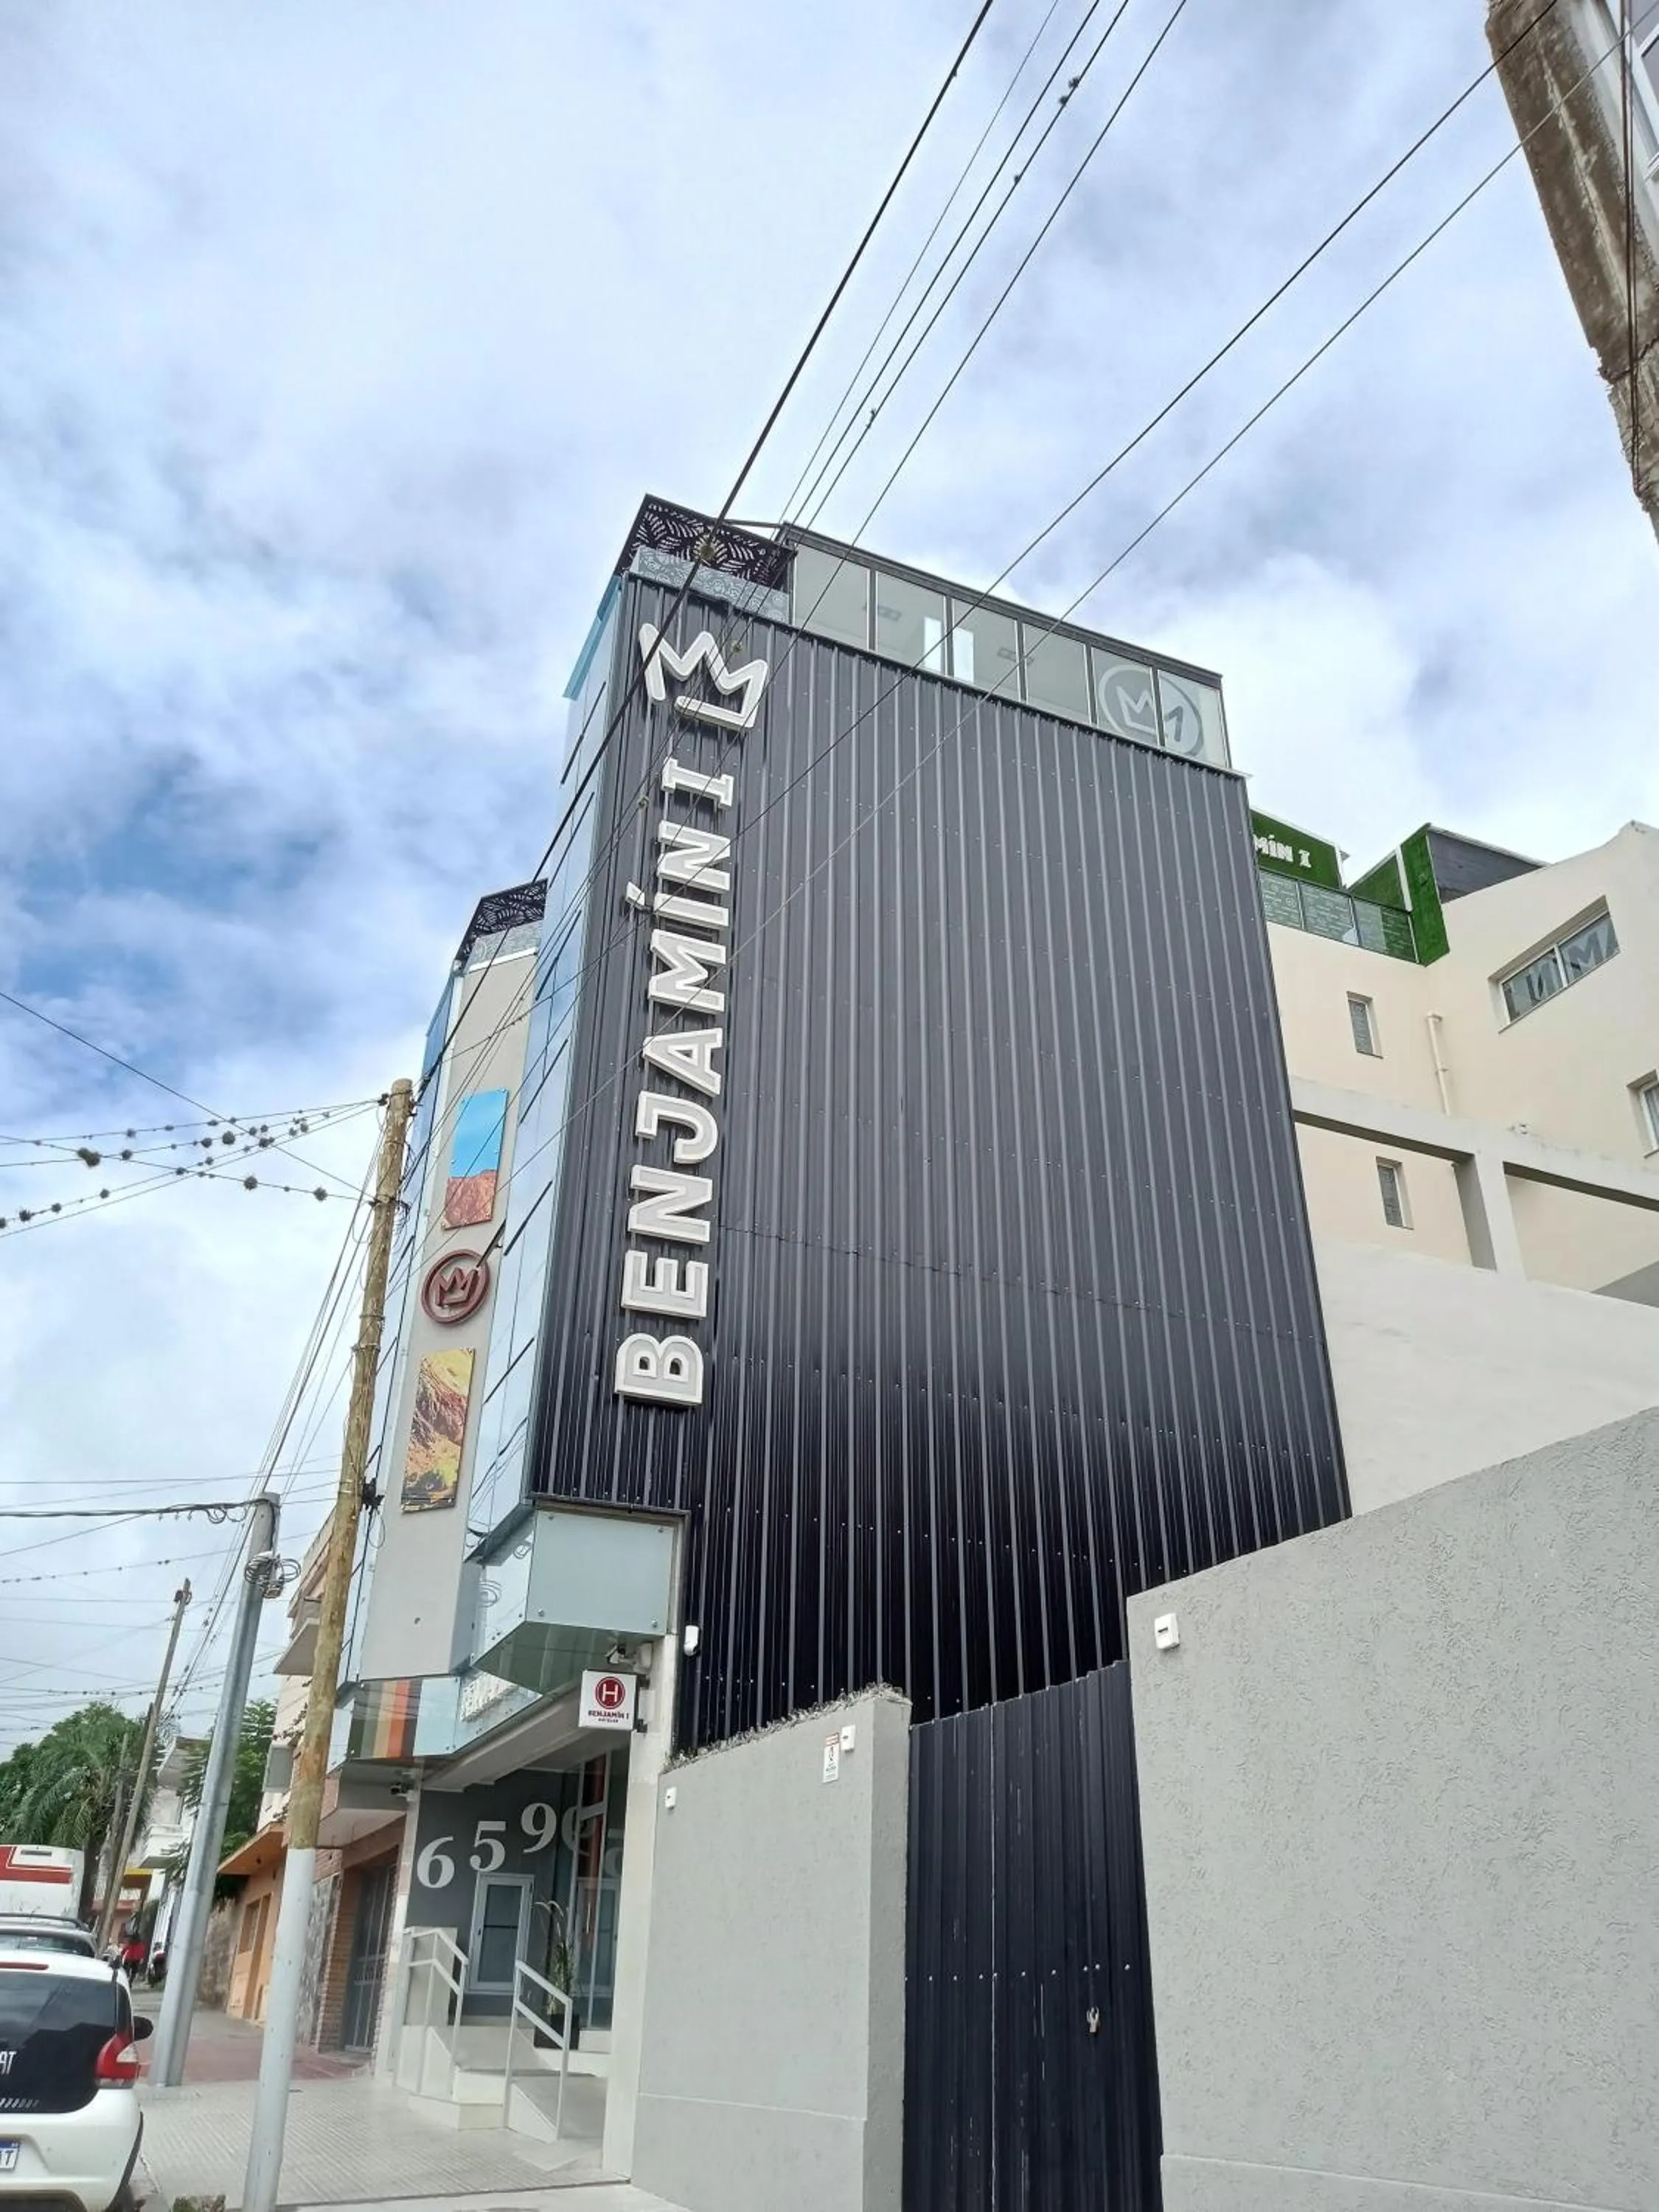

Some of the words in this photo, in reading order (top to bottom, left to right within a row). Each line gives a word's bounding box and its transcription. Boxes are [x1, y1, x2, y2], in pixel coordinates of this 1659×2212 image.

[661, 757, 734, 807] I
[614, 819, 731, 1405] BENJAMÍN
[602, 1683, 619, 1703] H
[417, 1803, 557, 1888] 659
